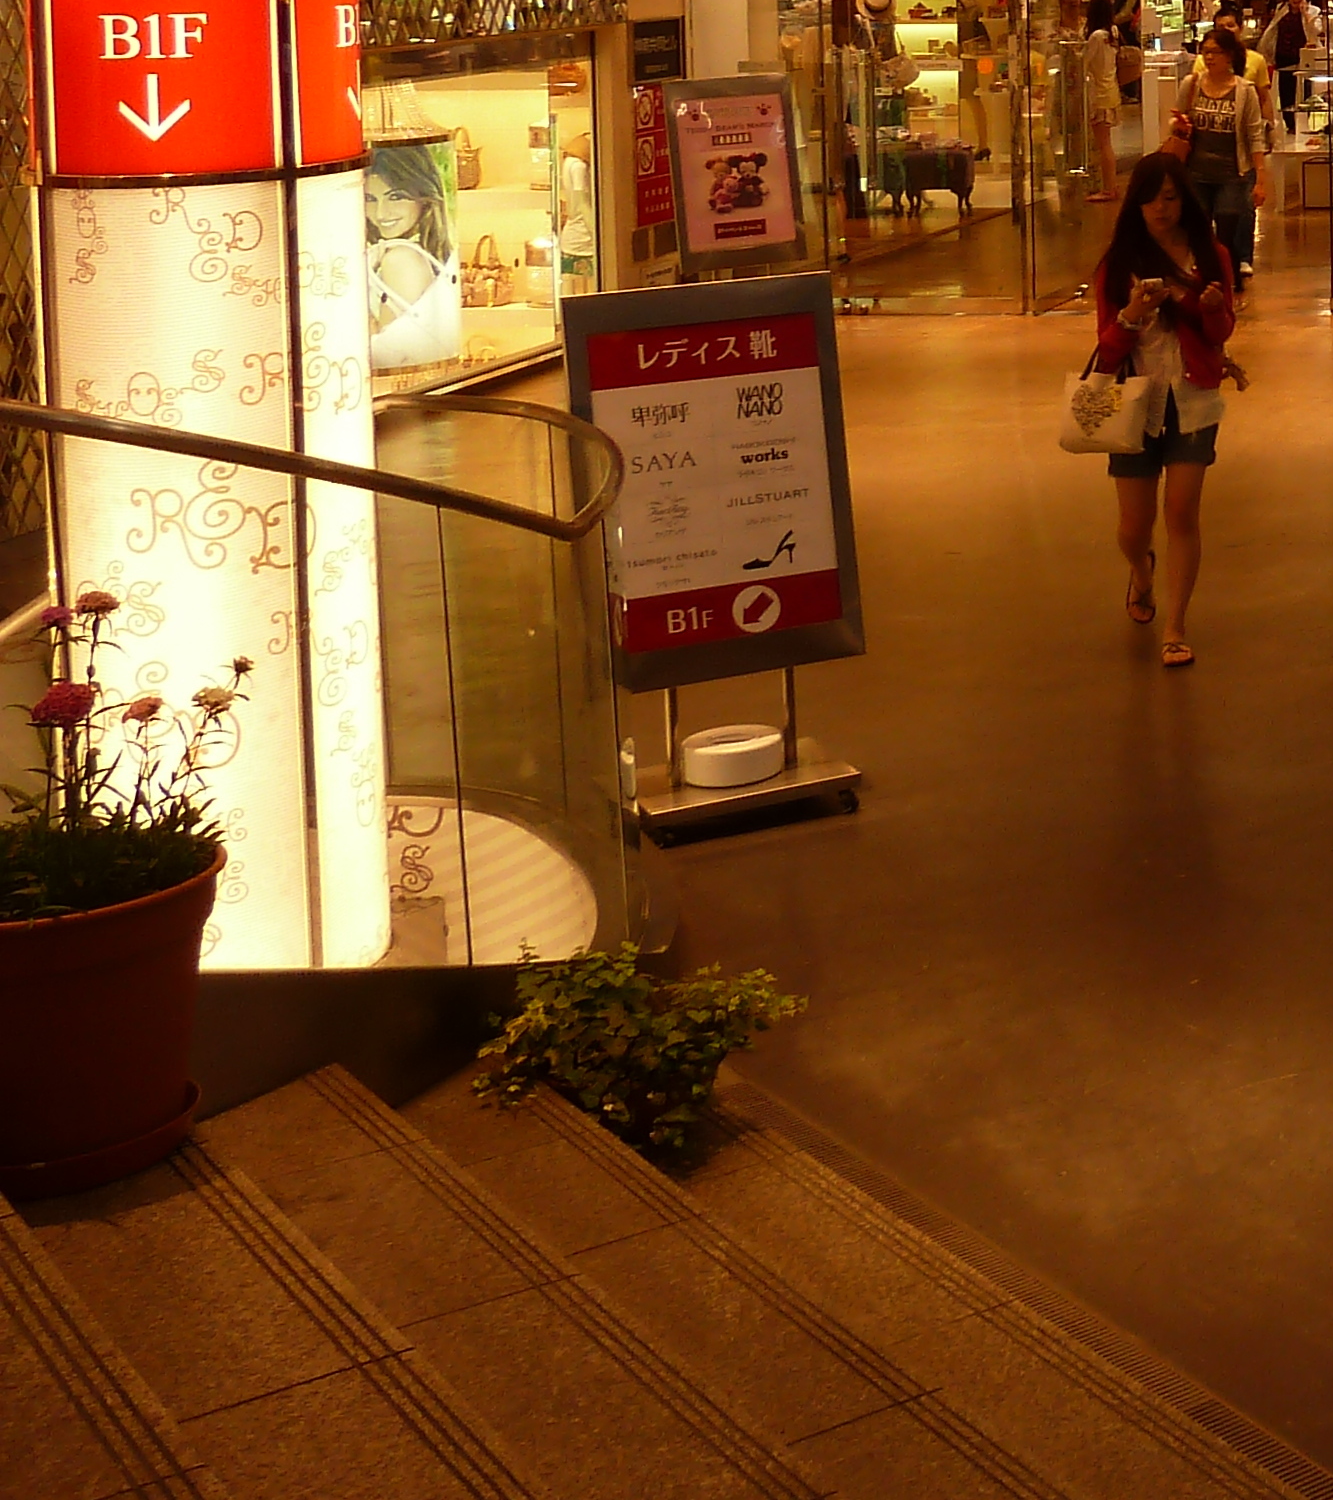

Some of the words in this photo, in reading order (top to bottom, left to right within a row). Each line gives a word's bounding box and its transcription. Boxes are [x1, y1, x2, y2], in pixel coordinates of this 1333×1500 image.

[98, 13, 208, 60] B1F
[736, 382, 783, 402] WANO
[631, 401, 690, 428] 卑弥呼
[736, 399, 783, 419] NANO
[631, 451, 697, 475] SAYA
[741, 448, 789, 465] works
[727, 487, 810, 509] JILLSTUART
[667, 606, 714, 634] B1F
